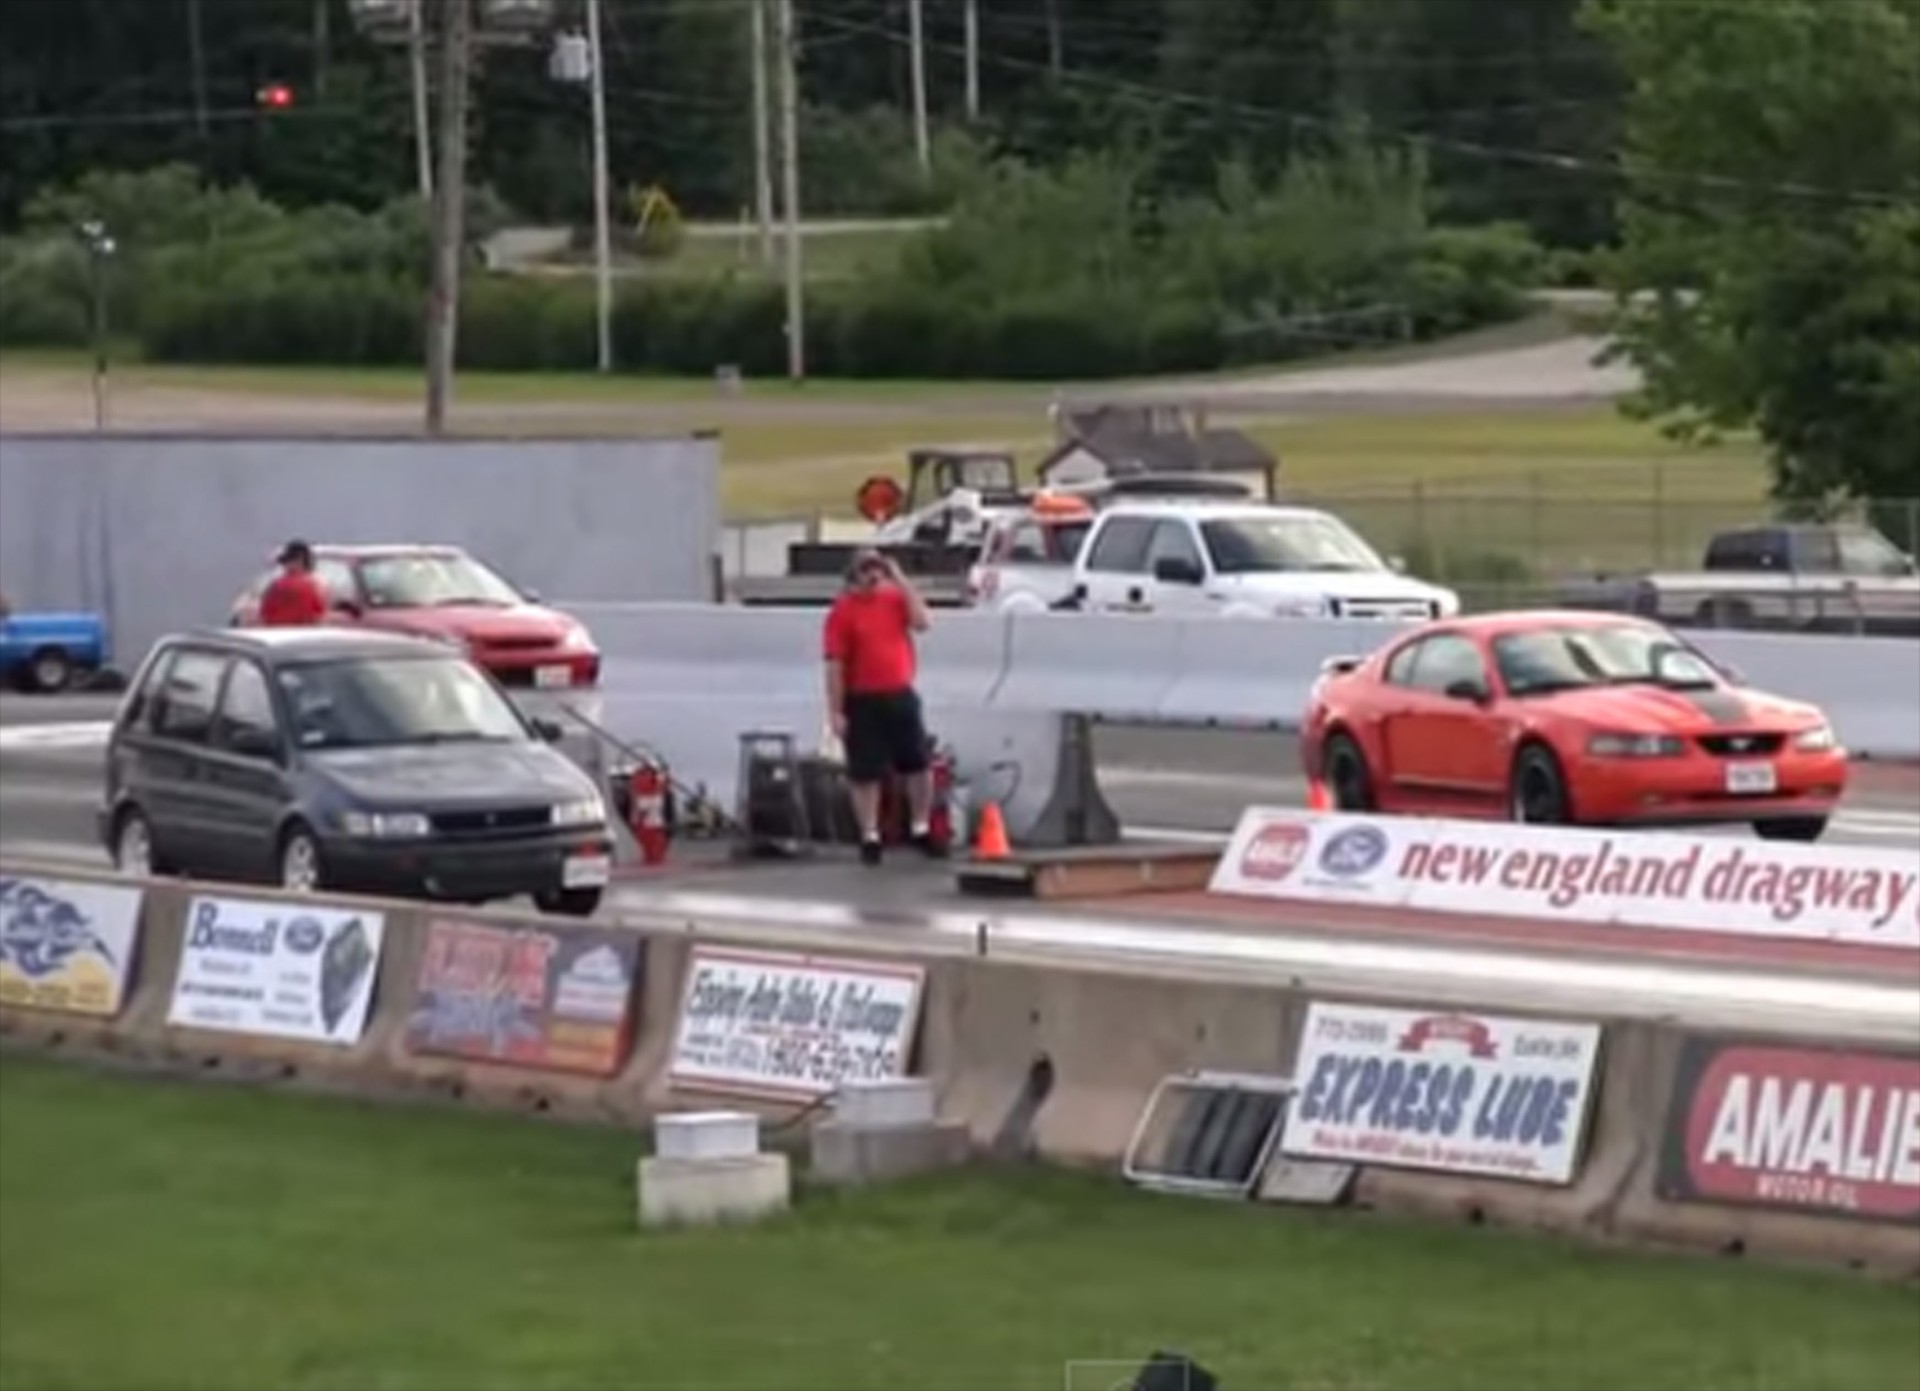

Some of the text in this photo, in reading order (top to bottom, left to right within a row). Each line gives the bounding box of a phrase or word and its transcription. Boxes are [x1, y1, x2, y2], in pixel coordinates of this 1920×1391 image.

[1398, 842, 1499, 885] new
[1500, 839, 1701, 908] england
[1702, 847, 1916, 929] dragway
[1300, 1053, 1579, 1147] EXPRESS LUBE
[1702, 1073, 1920, 1186] AMALIE
